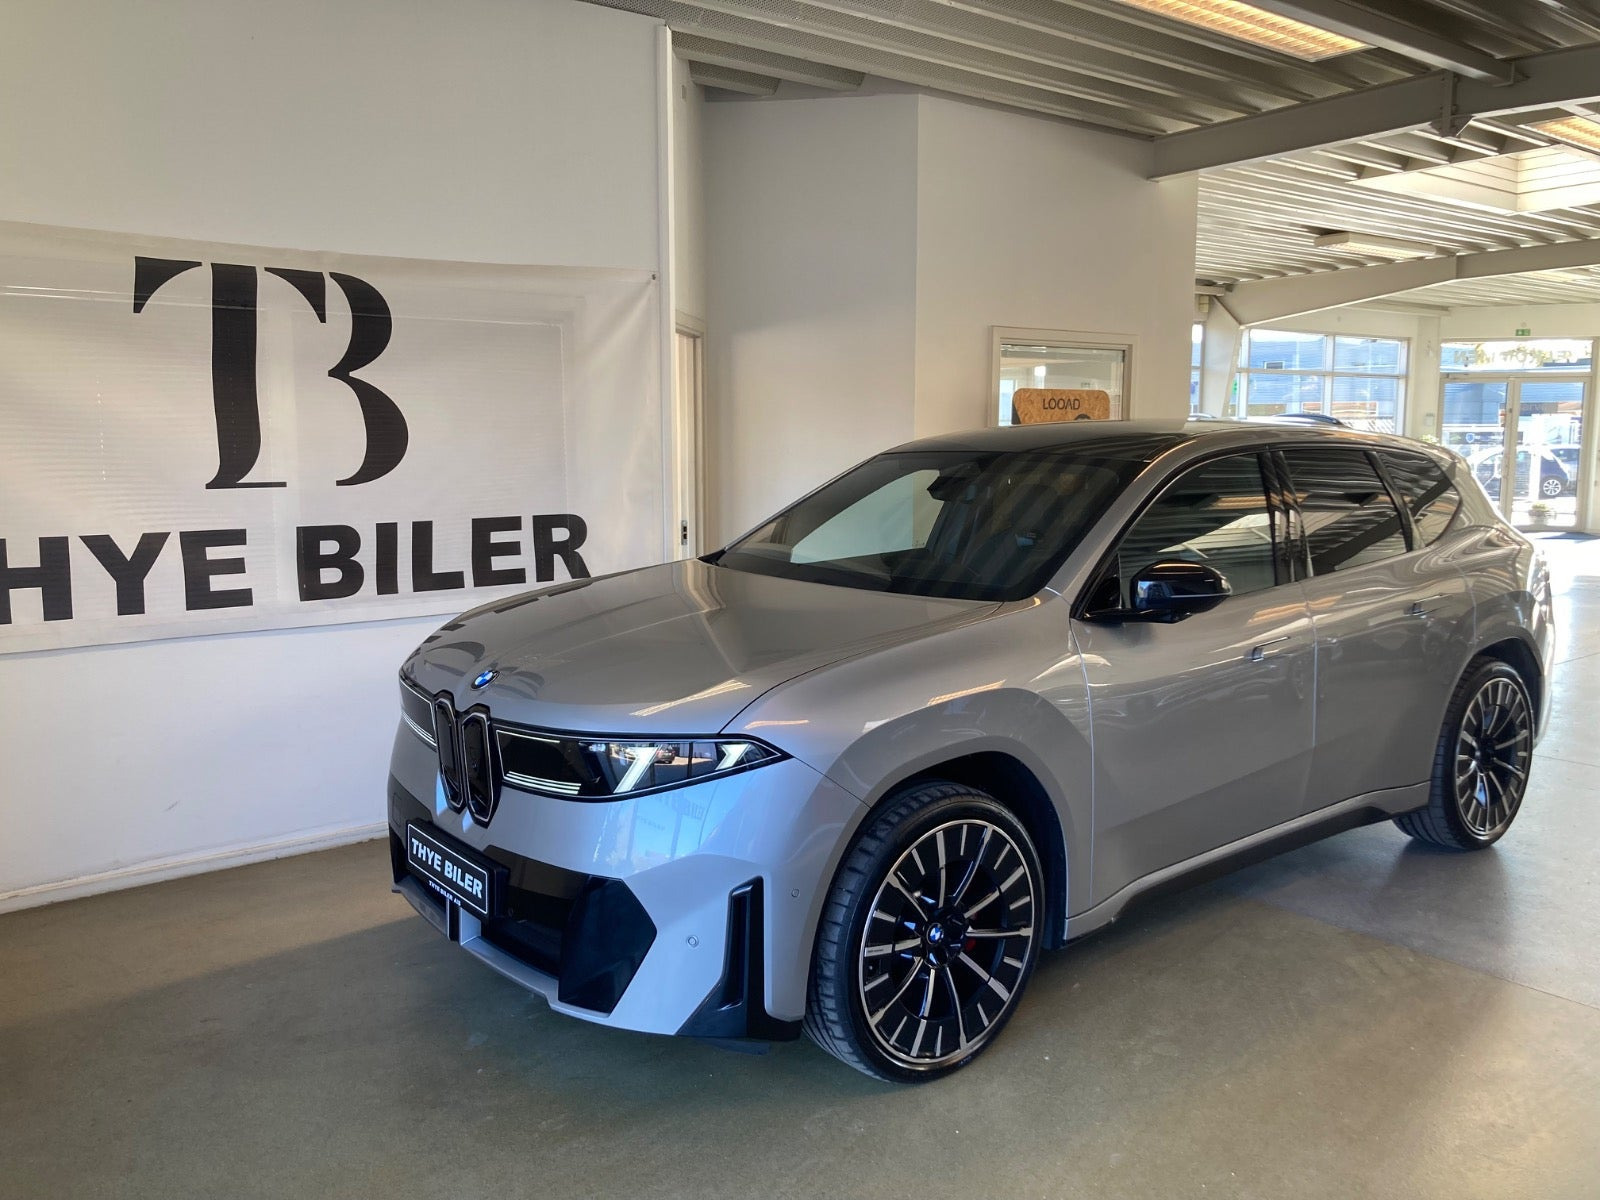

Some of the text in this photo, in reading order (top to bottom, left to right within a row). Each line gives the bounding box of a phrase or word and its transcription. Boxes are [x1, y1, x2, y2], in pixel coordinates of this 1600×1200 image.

[1042, 398, 1081, 411] LOOAD
[296, 513, 592, 602] BILER
[411, 837, 483, 899] THYE BILER
